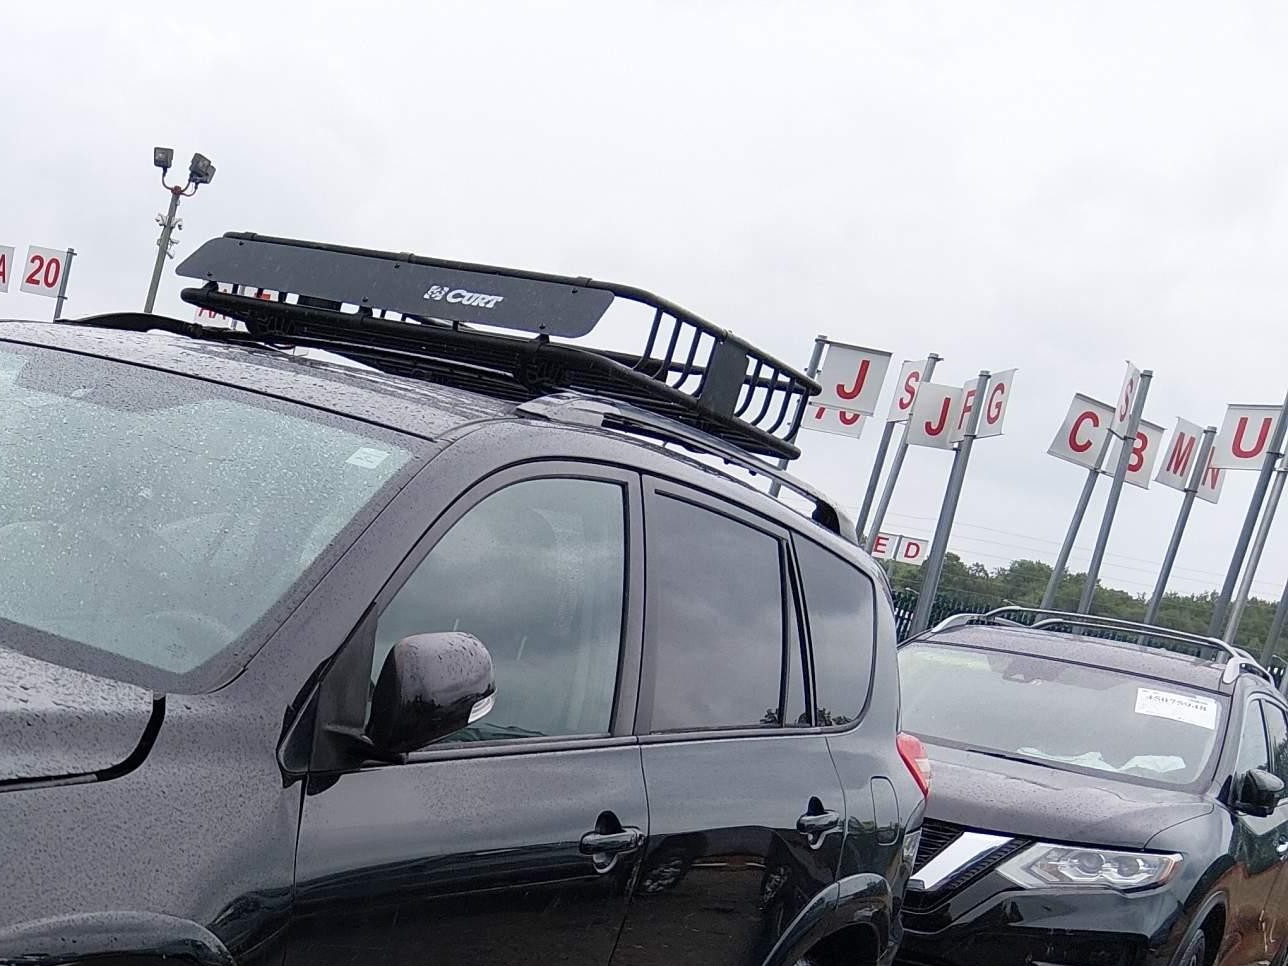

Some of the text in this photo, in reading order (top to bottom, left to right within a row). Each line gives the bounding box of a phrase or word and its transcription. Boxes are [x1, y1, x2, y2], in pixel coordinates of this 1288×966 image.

[25, 254, 61, 288] 20
[446, 289, 505, 309] CURT
[835, 359, 871, 400] J
[898, 370, 920, 410] S
[924, 397, 952, 437] J
[986, 382, 1005, 425] G
[1119, 377, 1134, 423] S
[1068, 410, 1100, 453] C
[1231, 416, 1273, 459] U
[1166, 431, 1197, 478] M
[873, 535, 890, 554] E
[903, 541, 921, 559] D
